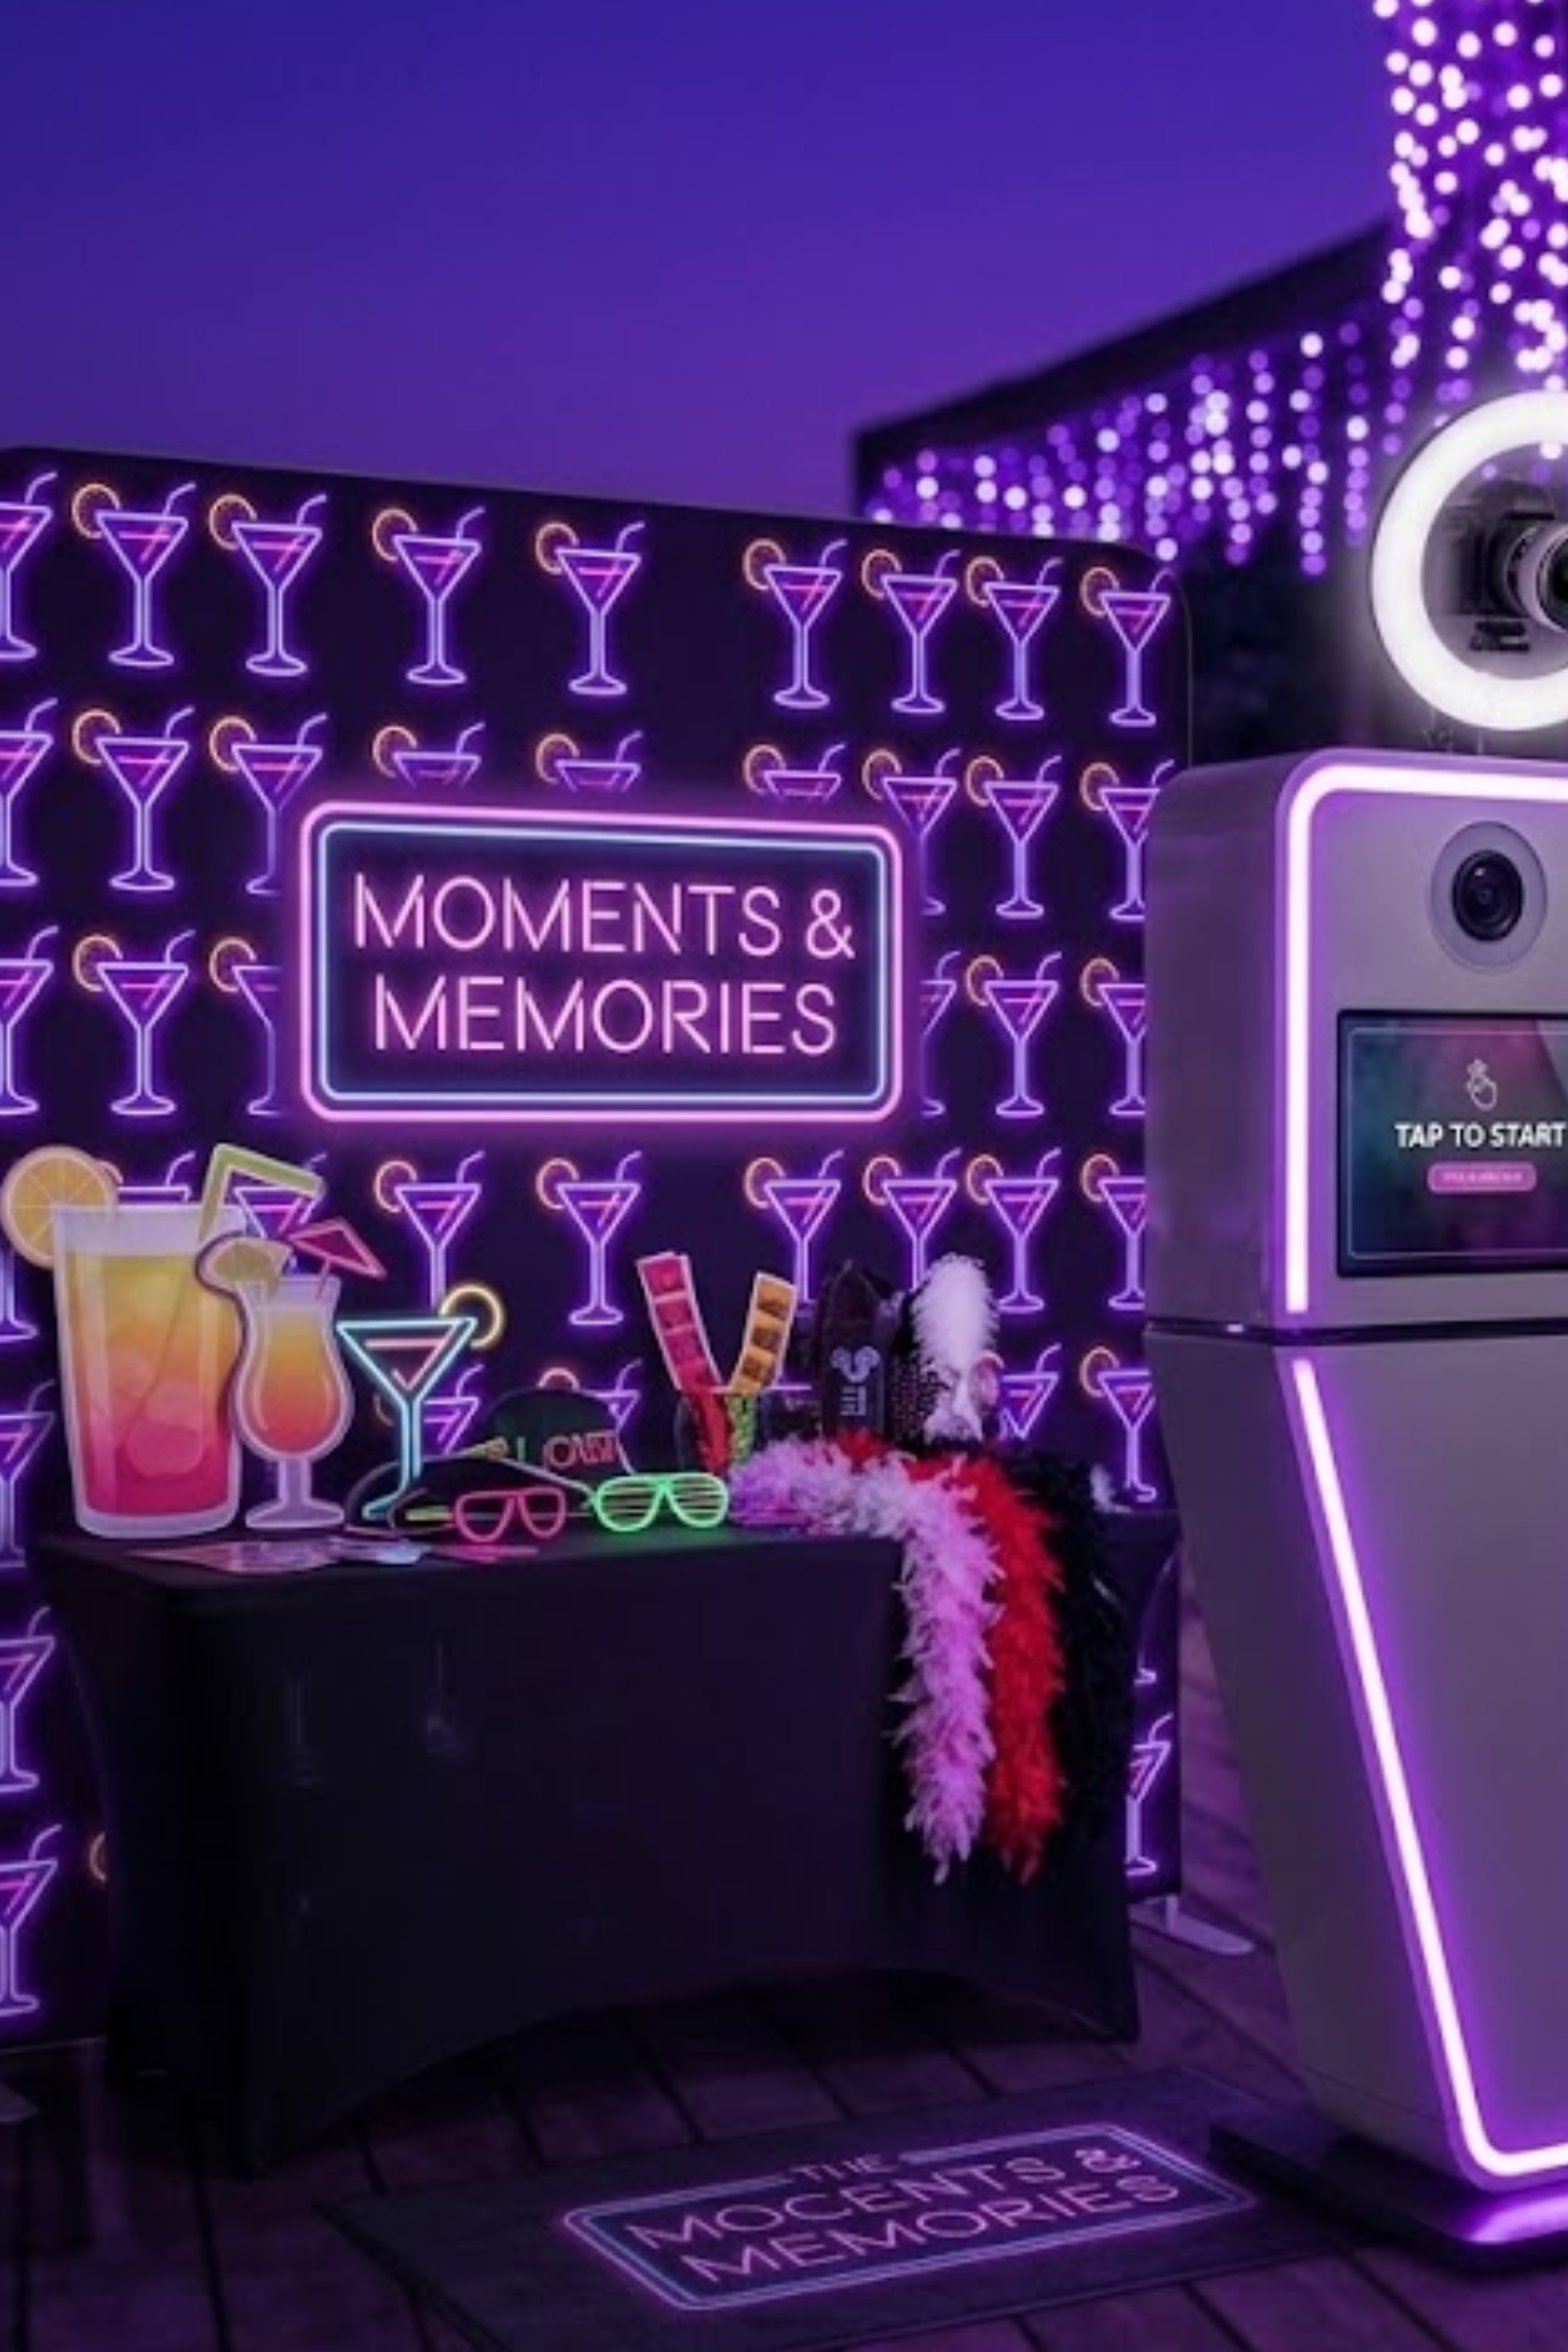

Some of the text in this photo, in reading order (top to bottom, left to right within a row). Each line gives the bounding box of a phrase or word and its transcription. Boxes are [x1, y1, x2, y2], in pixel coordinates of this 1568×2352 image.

[353, 872, 856, 959] MOMENTS &
[374, 973, 836, 1055] MEMORIES
[1394, 1121, 1567, 1148] TAP TO START
[680, 2174, 1179, 2282] MEMORIES
